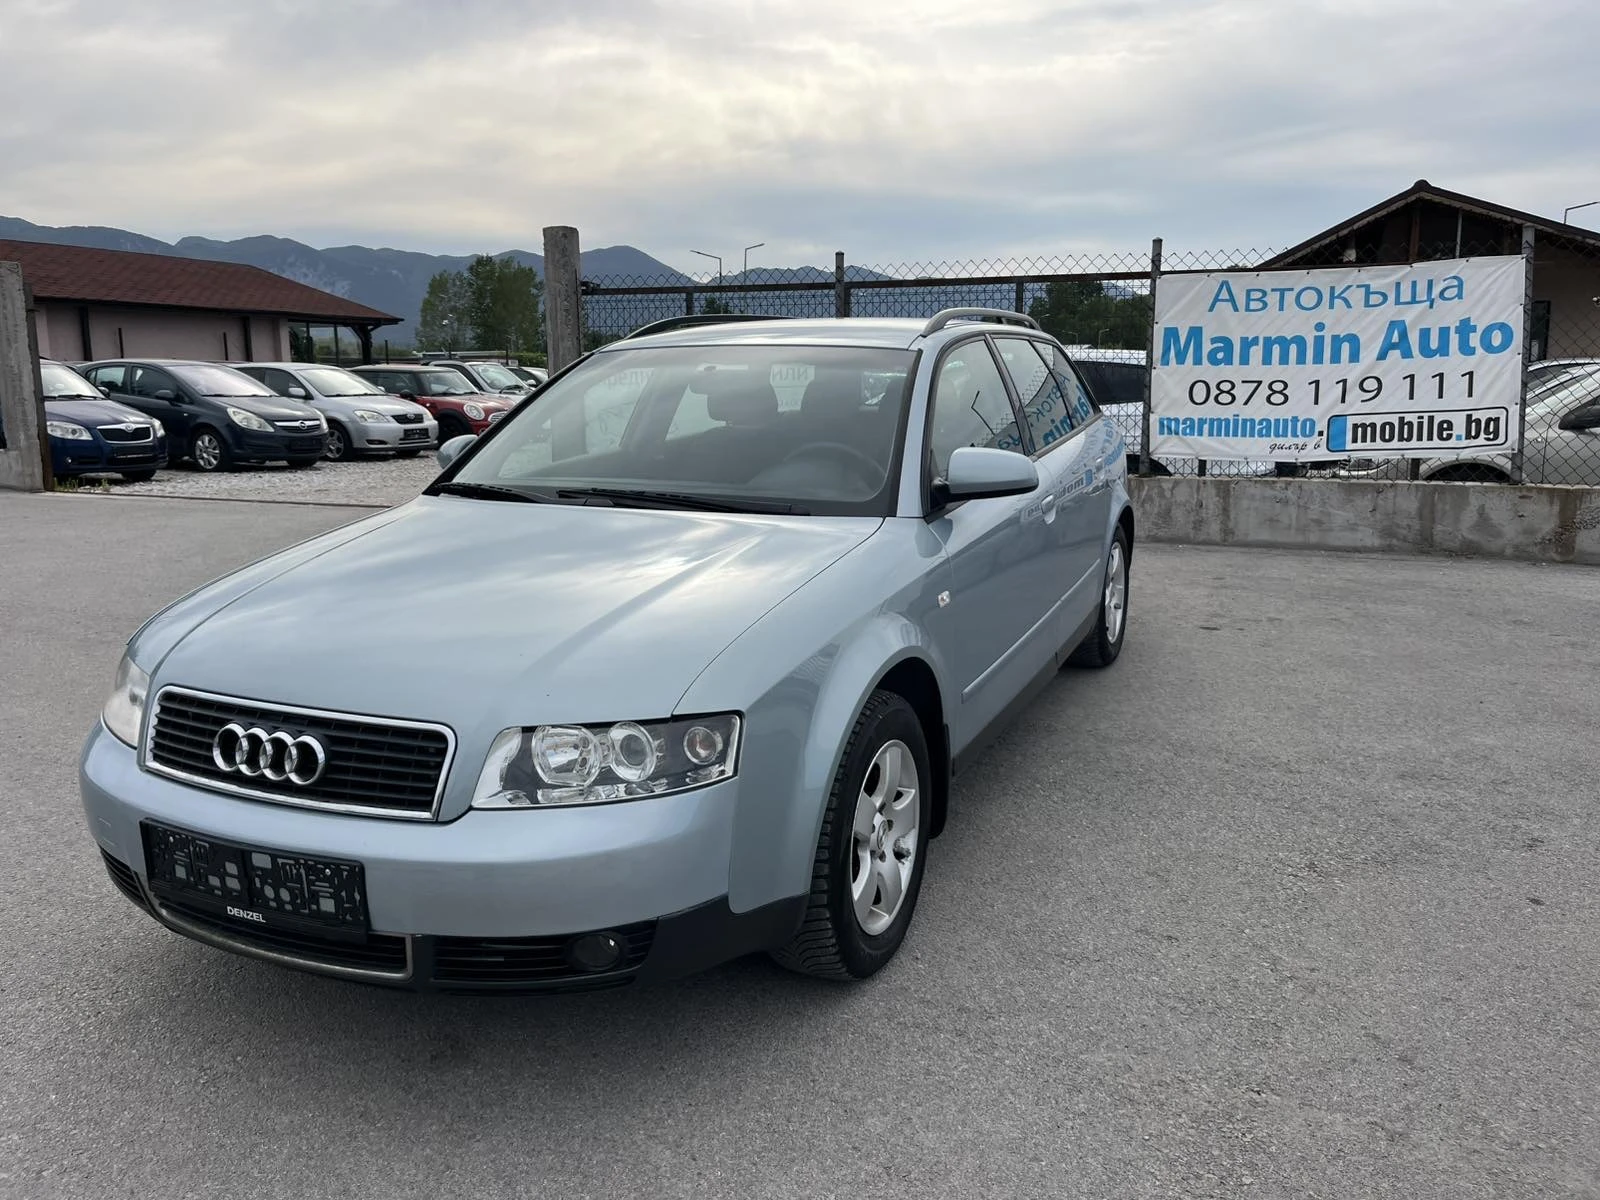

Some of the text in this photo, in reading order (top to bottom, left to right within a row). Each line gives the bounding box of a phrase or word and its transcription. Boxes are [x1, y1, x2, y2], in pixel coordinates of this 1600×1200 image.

[1160, 317, 1514, 367] Marmin Auto
[1188, 370, 1475, 406] 0878 119 111
[1351, 414, 1501, 445] mobile.bg
[226, 905, 267, 923] DENZEL
